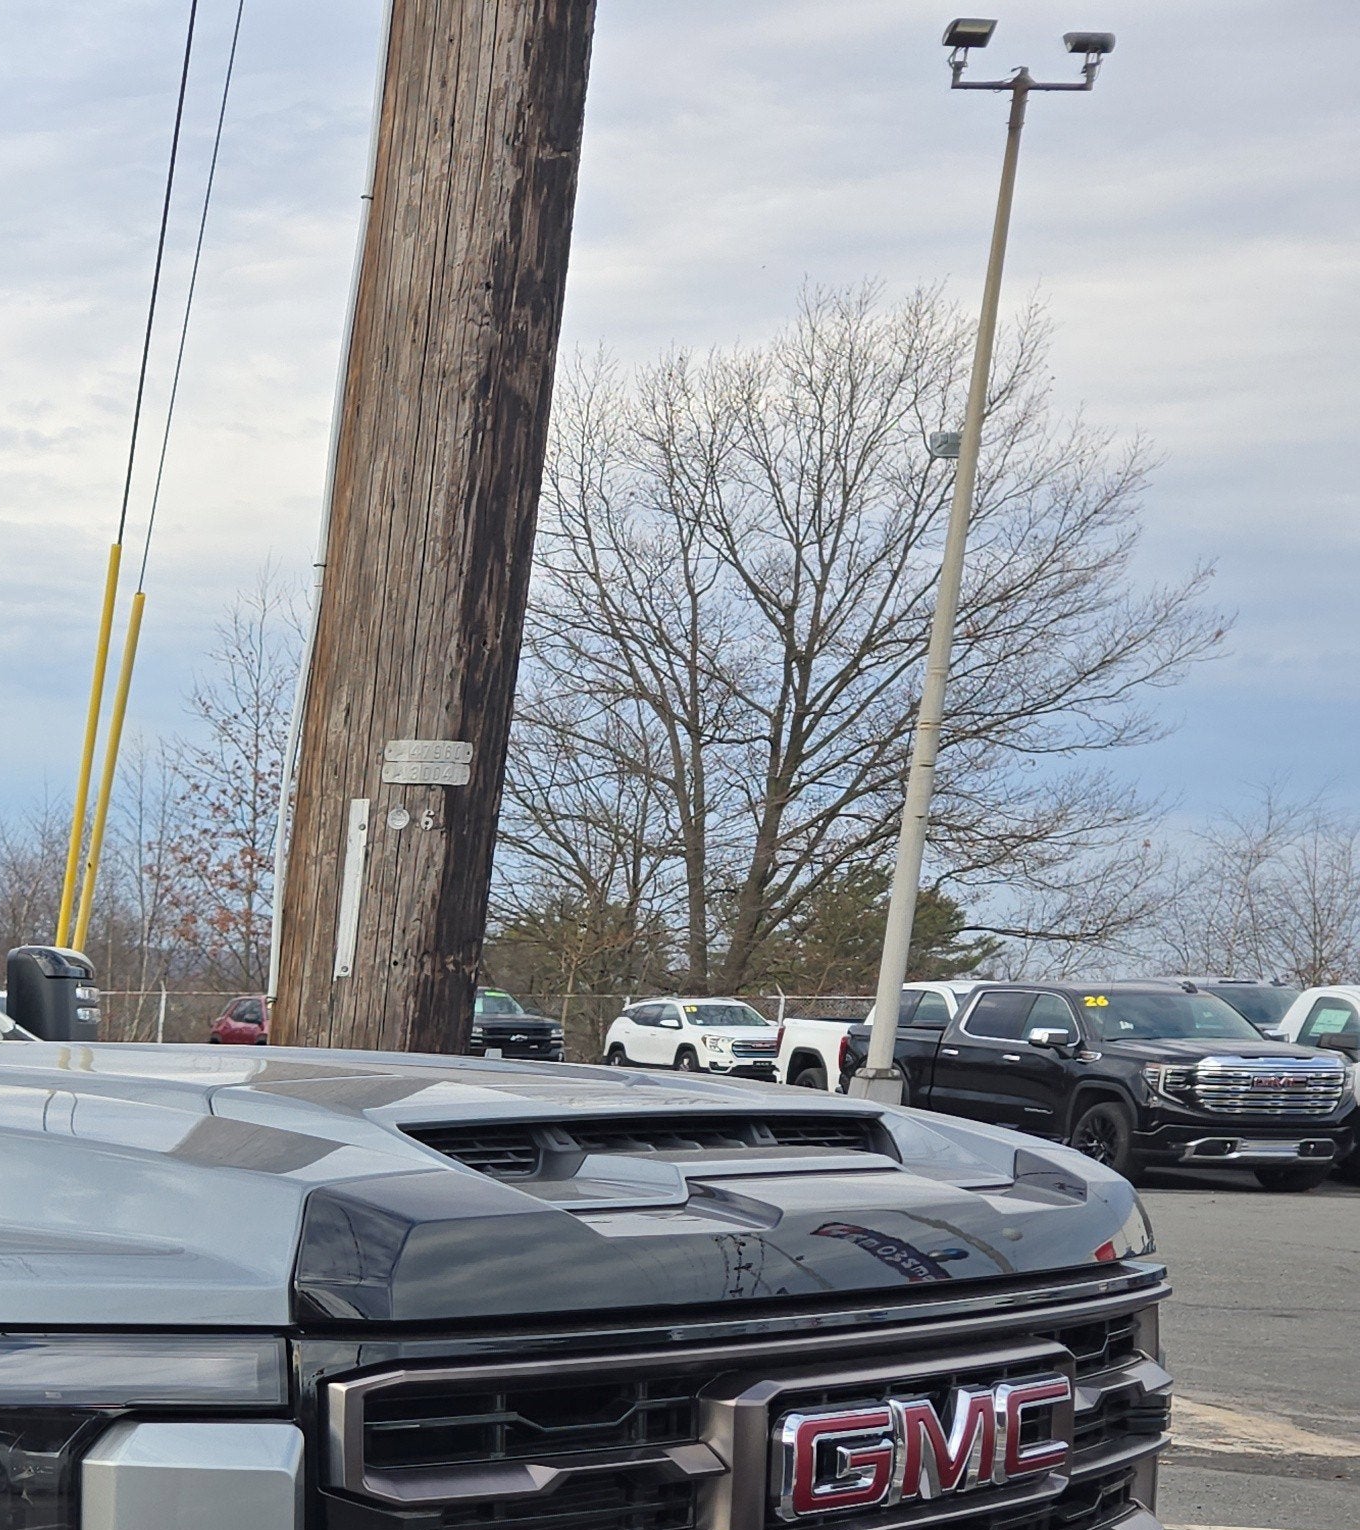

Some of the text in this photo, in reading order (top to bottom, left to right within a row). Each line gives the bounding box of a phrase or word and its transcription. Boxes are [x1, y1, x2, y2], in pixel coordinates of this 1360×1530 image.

[421, 810, 435, 831] 6
[1083, 995, 1109, 1007] 26
[780, 1374, 1072, 1521] GMC
